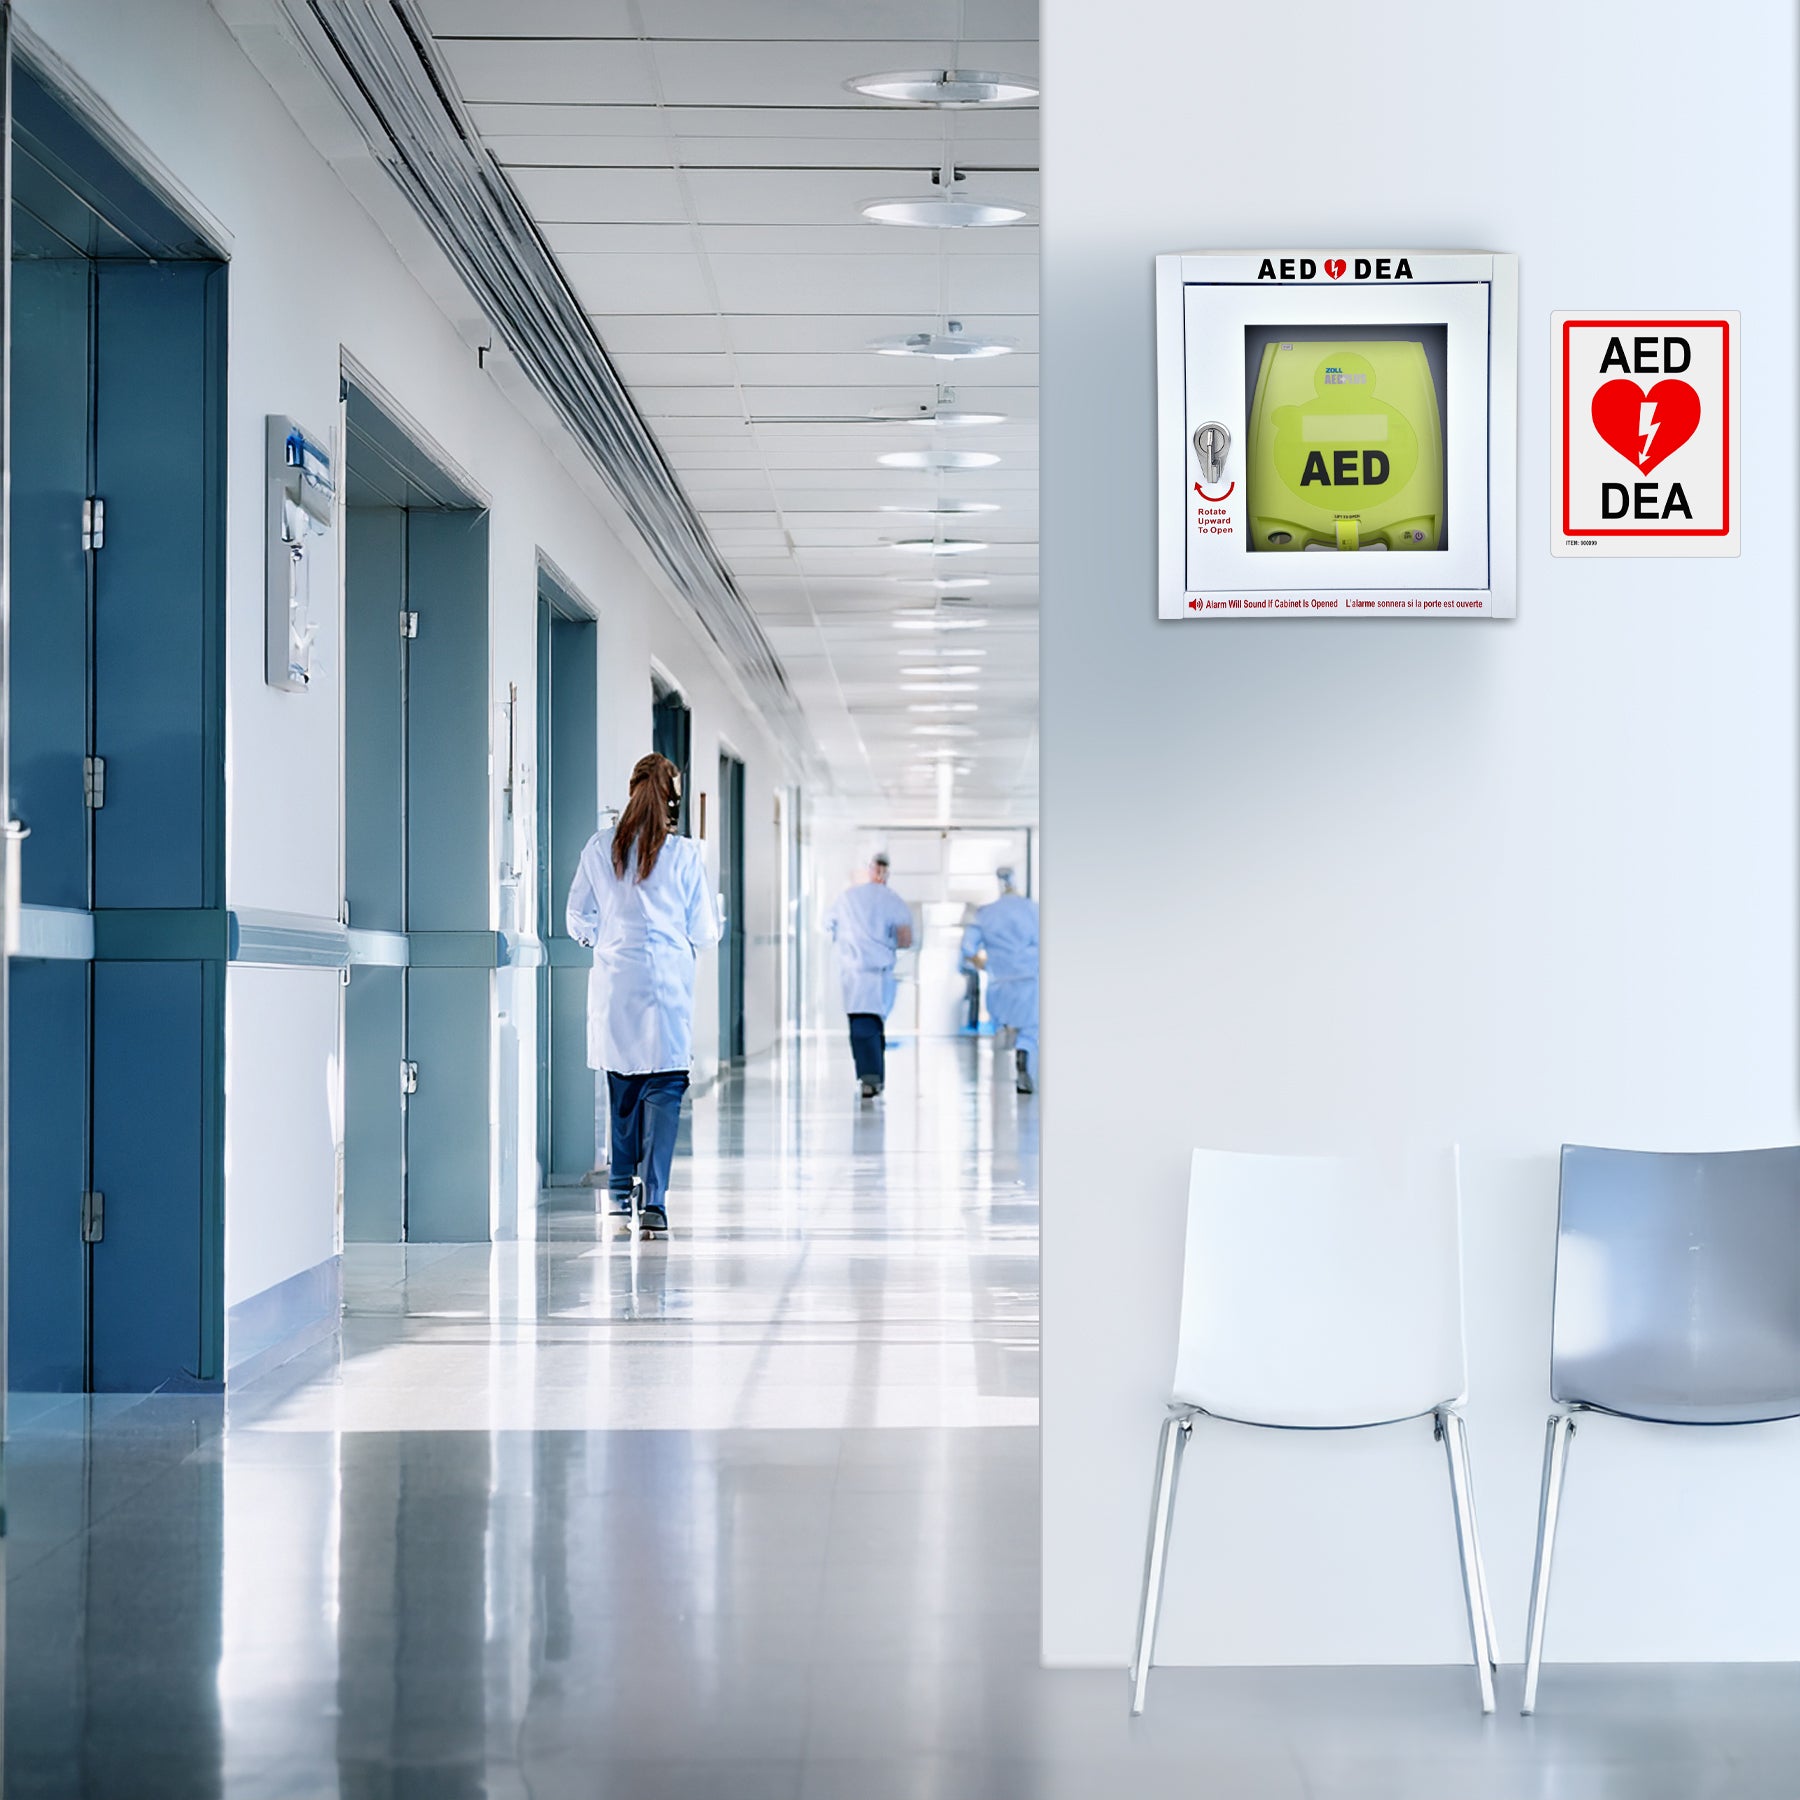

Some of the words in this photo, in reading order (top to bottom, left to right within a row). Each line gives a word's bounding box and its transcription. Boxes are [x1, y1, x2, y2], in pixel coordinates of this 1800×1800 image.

[1257, 259, 1317, 279] AED
[1354, 259, 1414, 279] DEA
[1599, 336, 1692, 374] AED
[1300, 450, 1390, 487] AED
[1601, 482, 1693, 520] DEA
[1198, 517, 1231, 525] Upward
[1198, 526, 1209, 534] To
[1210, 526, 1233, 535] Open
[1205, 599, 1227, 609] Alarm
[1228, 599, 1242, 609] Will
[1243, 599, 1267, 609] Sound
[1267, 599, 1274, 608] If
[1274, 599, 1302, 608] Cabinet
[1303, 599, 1310, 608] Is
[1311, 599, 1338, 610] Opened
[1345, 599, 1376, 608] L'alarme
[1377, 600, 1406, 608] sonnera
[1407, 599, 1414, 608] si
[1415, 599, 1422, 608] la
[1423, 599, 1442, 610] porte
[1443, 599, 1455, 608] est
[1455, 599, 1483, 608] ouverte
